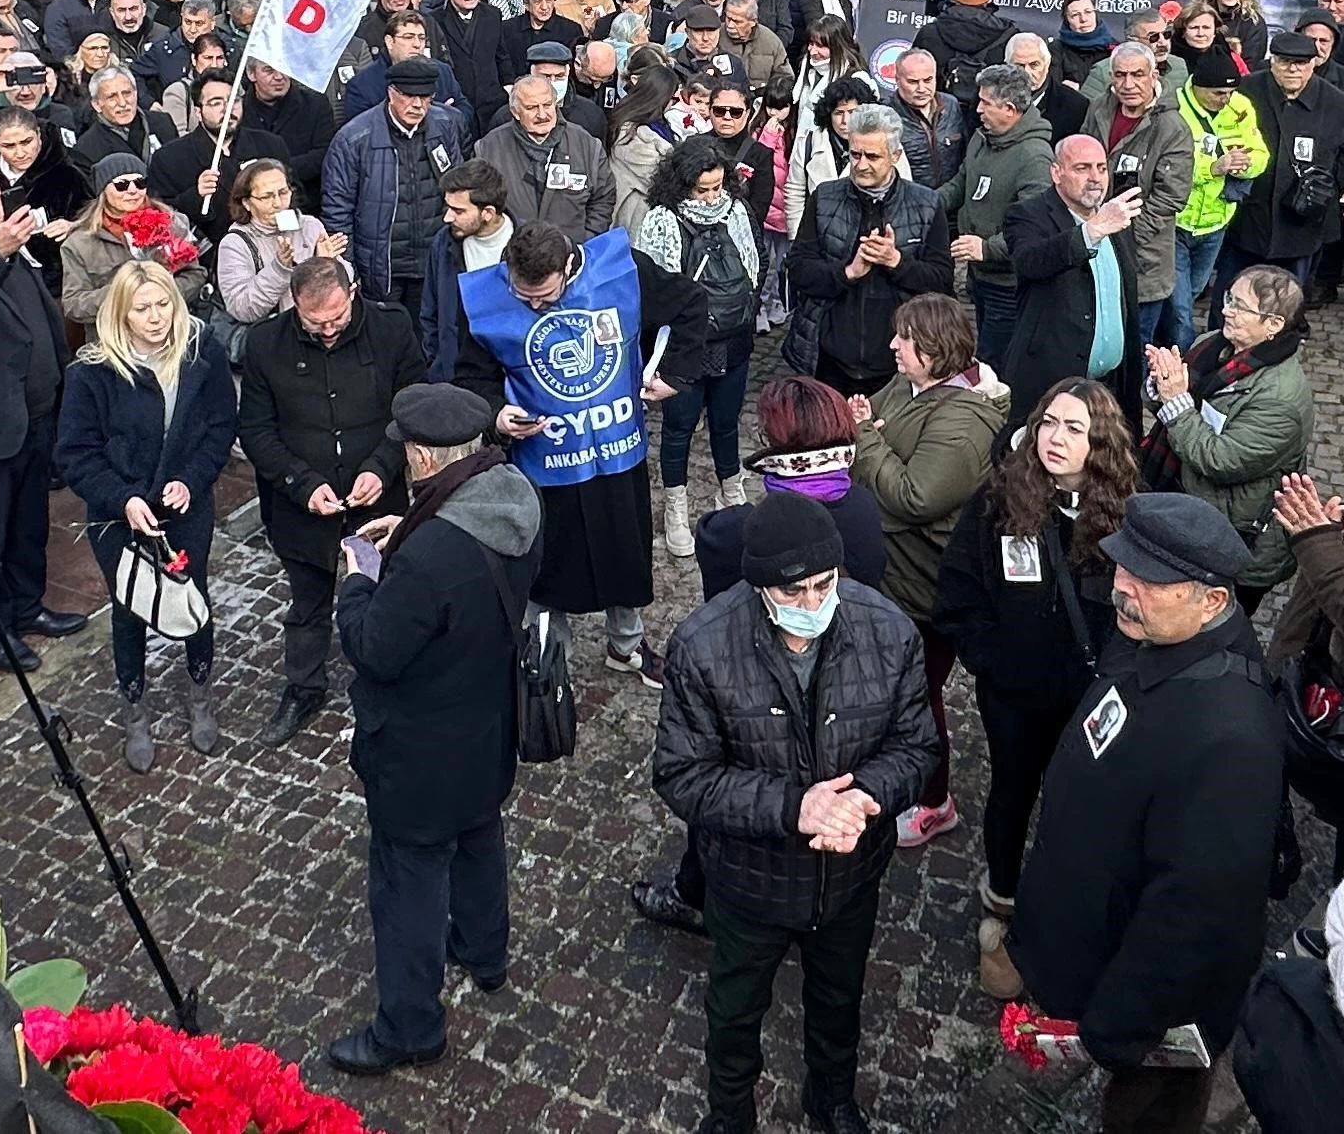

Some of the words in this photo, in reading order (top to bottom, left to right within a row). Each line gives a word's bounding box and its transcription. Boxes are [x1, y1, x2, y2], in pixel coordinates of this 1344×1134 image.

[886, 10, 908, 25] Bir
[534, 357, 592, 395] DESTEKLEME
[542, 396, 634, 446] ÇYDD
[545, 447, 598, 469] ANKARA
[600, 426, 642, 461] ŞUBESİ
